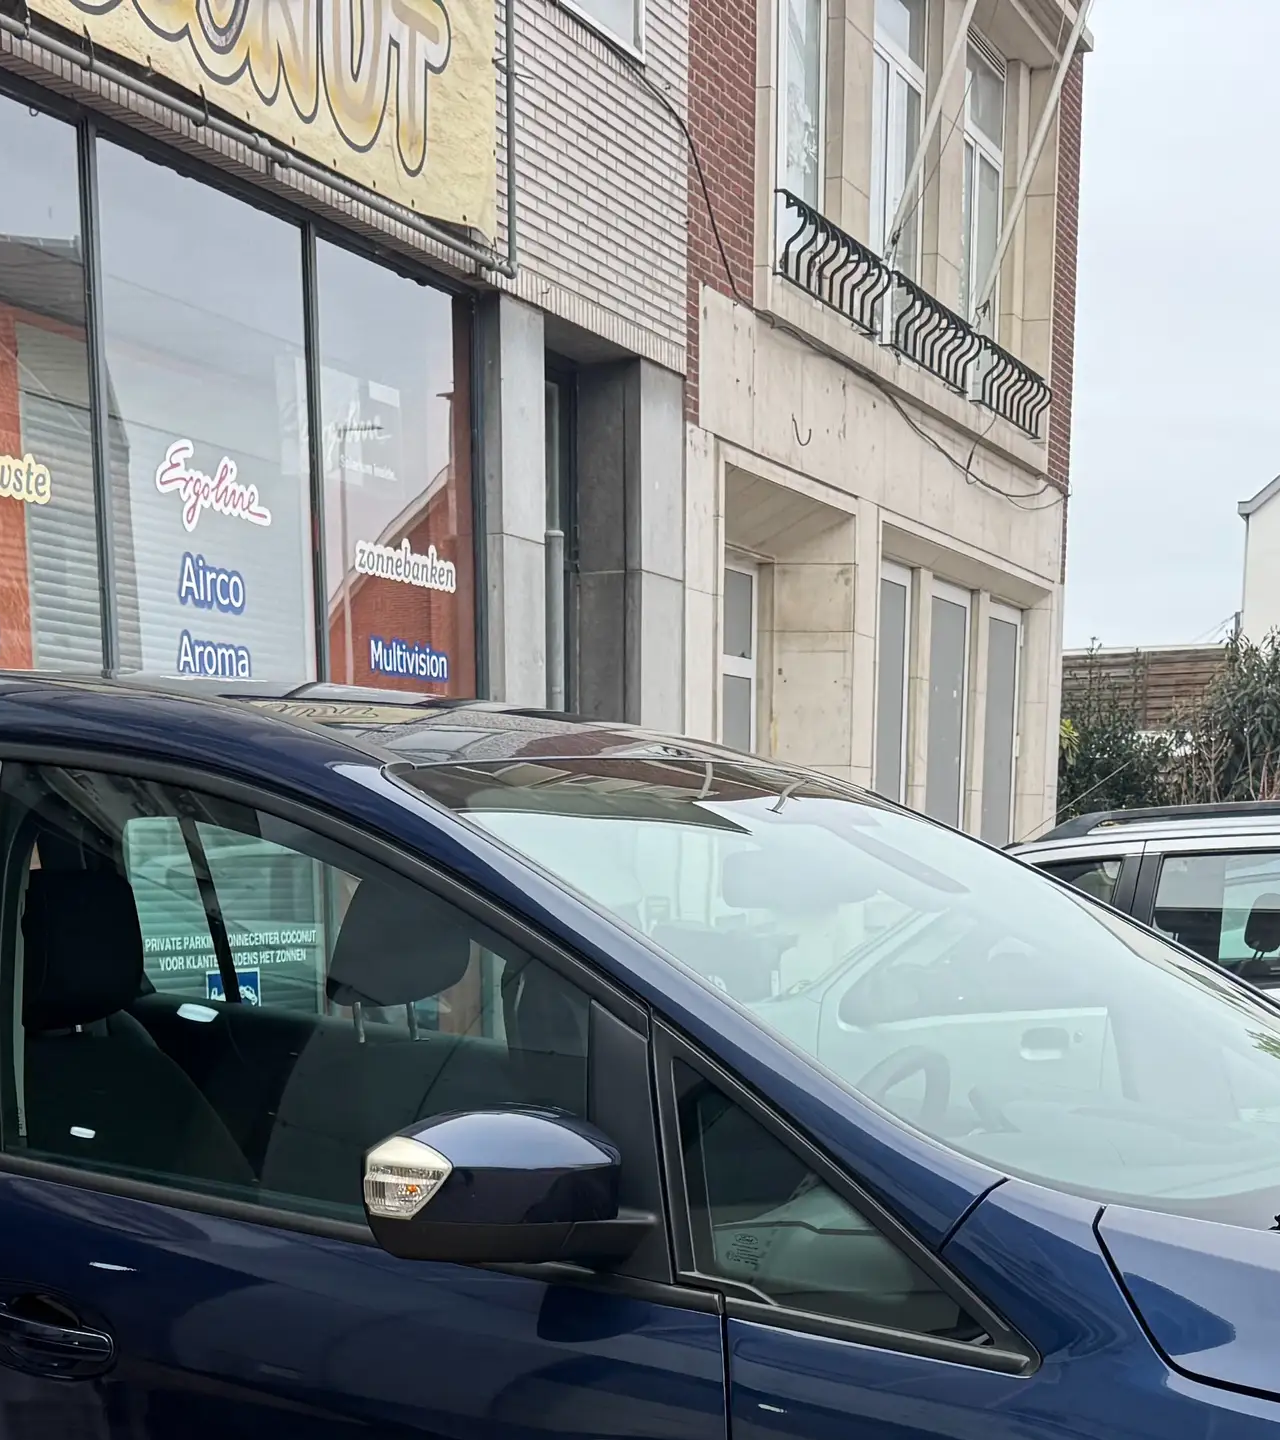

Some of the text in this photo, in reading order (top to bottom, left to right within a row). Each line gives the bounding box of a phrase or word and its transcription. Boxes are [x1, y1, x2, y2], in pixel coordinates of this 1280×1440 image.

[158, 446, 268, 526] Ergoline
[180, 556, 244, 609] Airco
[357, 546, 455, 588] zonnebanken
[179, 635, 251, 679] Aroma
[370, 639, 449, 680] Multivision
[144, 929, 317, 952] PRIVATE PARKIN ONNECENTER COCONUT
[159, 956, 185, 971] VOOR
[185, 954, 219, 969] KLANTE
[259, 950, 275, 964] HET
[275, 948, 307, 963] ZONNEN
